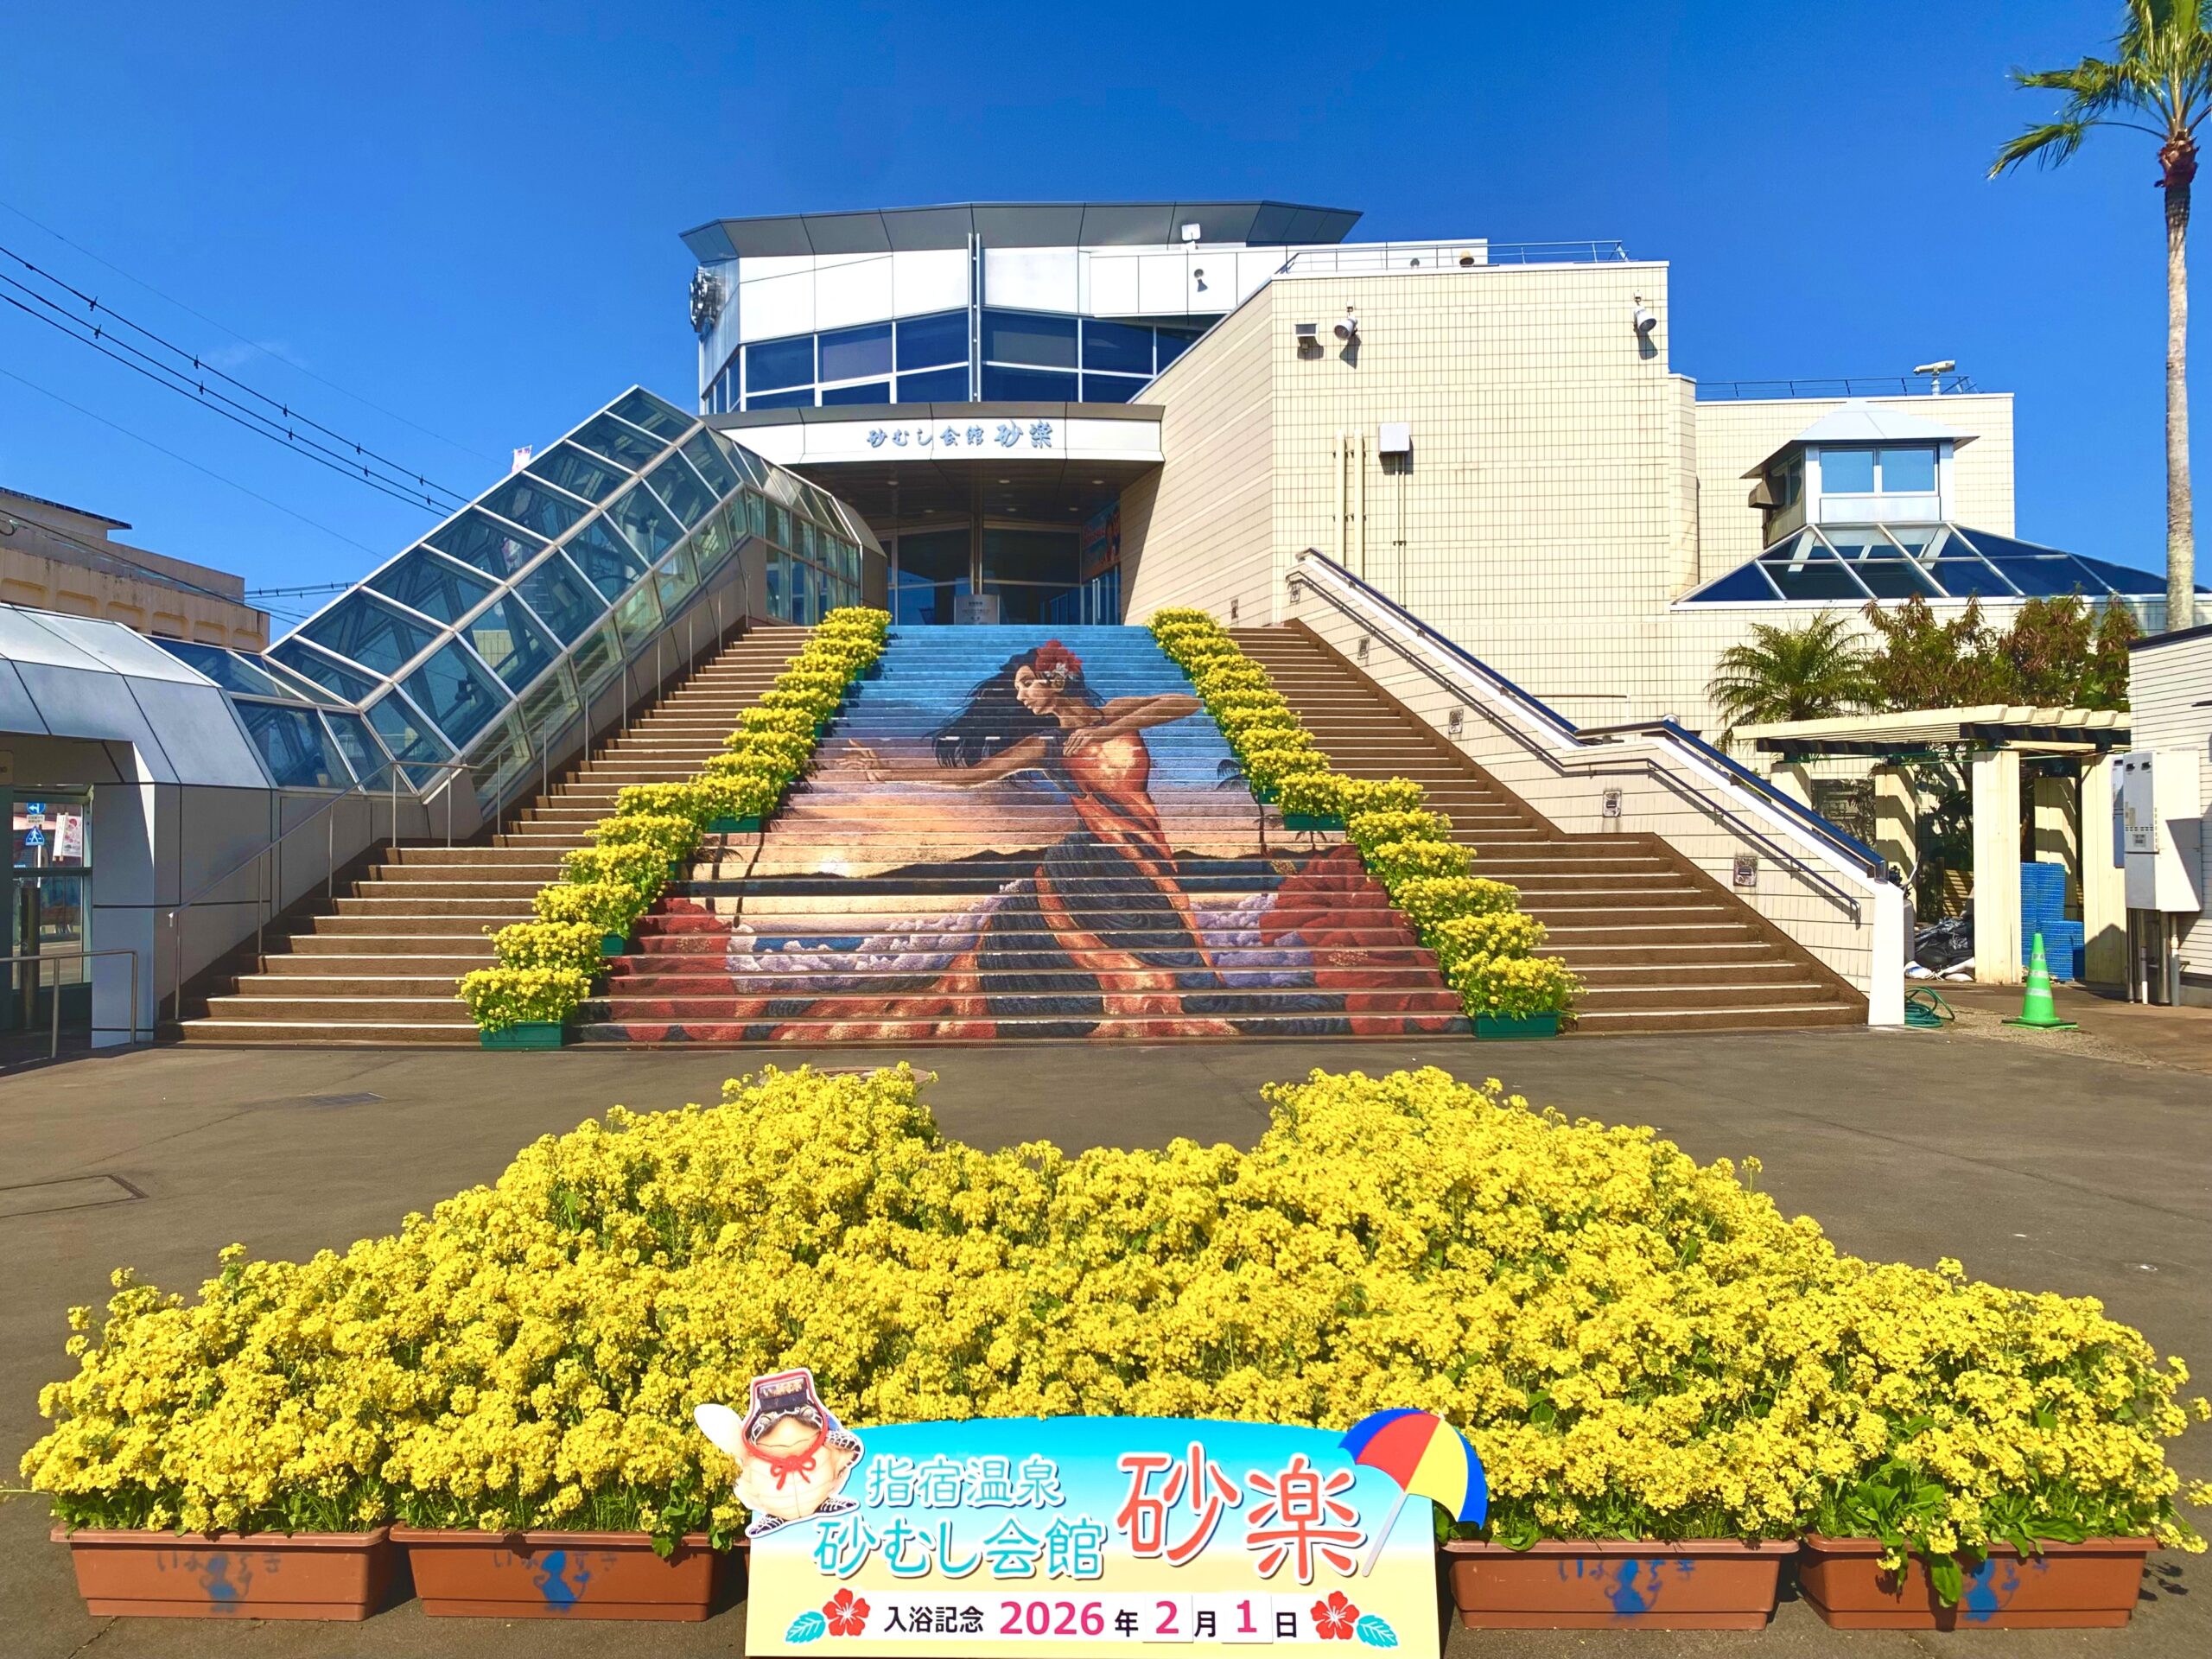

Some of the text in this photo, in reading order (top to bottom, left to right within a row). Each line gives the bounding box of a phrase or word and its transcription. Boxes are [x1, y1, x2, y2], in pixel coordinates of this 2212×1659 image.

[867, 419, 1053, 449] 砂むし会館 砂楽
[868, 1457, 1059, 1504] 指宿温泉
[1116, 1444, 1364, 1580] 砂楽
[813, 1516, 1104, 1576] 砂むし会館
[883, 1605, 984, 1633] 入浴記念
